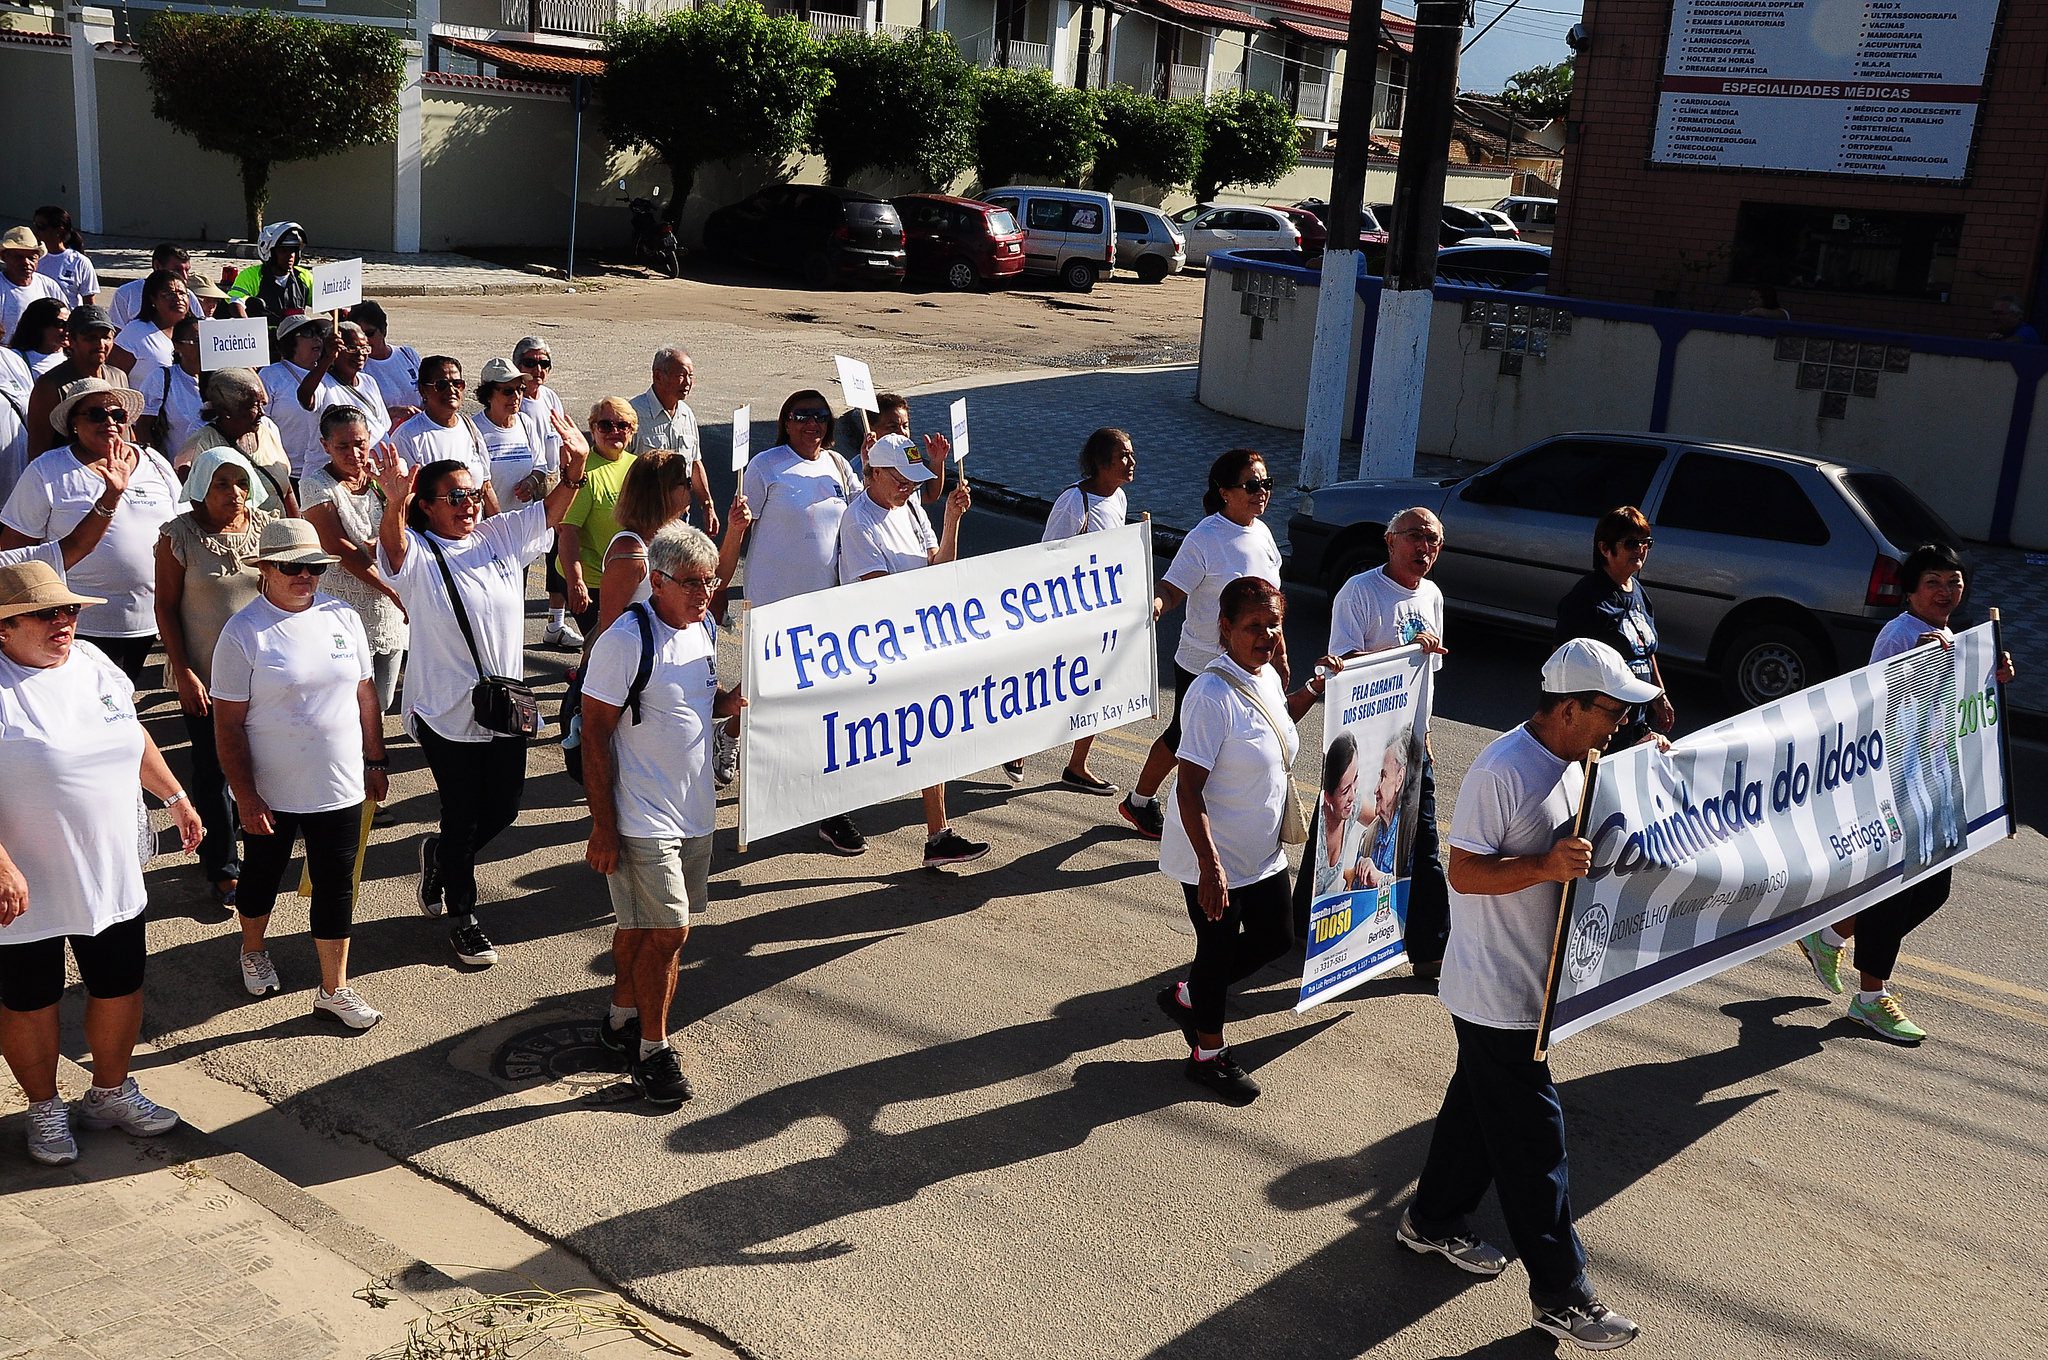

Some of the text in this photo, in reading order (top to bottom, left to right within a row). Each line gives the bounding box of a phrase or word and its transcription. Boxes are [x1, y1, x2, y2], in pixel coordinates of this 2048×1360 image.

[1695, 0, 1767, 8] ECOCARDIOGRAFIA
[1872, 2, 1894, 10] RAIO
[1870, 12, 1957, 20] ULTRASSONOGRAFIA
[1690, 28, 1742, 36] FISIOTERAPIA
[1685, 65, 1768, 74] DRENAGEM LINFÁTICA
[1860, 70, 1943, 79] IMPEDÂNCIOMETRIA
[1722, 82, 1911, 99] ESPECIALIDADES MÉDICAS
[1679, 107, 1739, 116] CLÍNICA MÉDICA
[1854, 105, 1886, 113] MÉDICO
[1901, 108, 1962, 116] ADOLESCENTE
[1678, 117, 1735, 125] DERMATOLOGIA
[1852, 114, 1884, 123] MÉDICO
[1900, 117, 1944, 125] TRABALHO
[1676, 126, 1742, 135] FONOAUDIOLOGIA
[1851, 125, 1904, 133] OBSTETRÍCIA
[1675, 135, 1757, 144] GASTROENTEROLOGIA
[1849, 134, 1912, 143] OFTALMOLOGIA
[1674, 144, 1724, 152] GINECOLOGIA
[1848, 144, 1893, 152] ORTOPEDIA
[1672, 153, 1717, 161] PSICOLOGIA
[1846, 153, 1948, 164] OTORRINOLARINGOLOGIA
[1844, 162, 1886, 170] PEDIATRIA
[322, 276, 351, 295] Amizade
[213, 334, 256, 352] Paciência
[1000, 554, 1124, 631] sentir
[1351, 674, 1404, 702] PELA GARANTIA
[1070, 694, 1148, 731] Mary Kay Ash
[1343, 692, 1408, 726] DOS SEUS DIREITOS
[1958, 688, 1997, 738] 2015
[1588, 722, 1884, 881] Caminhada do Idoso
[1830, 820, 1887, 861] Bertioga
[1610, 870, 1787, 942] CONSELHO MUNICIPAL DO IDOSO
[1316, 908, 1352, 944] IDOSO
[1368, 925, 1395, 944] Bertioga
